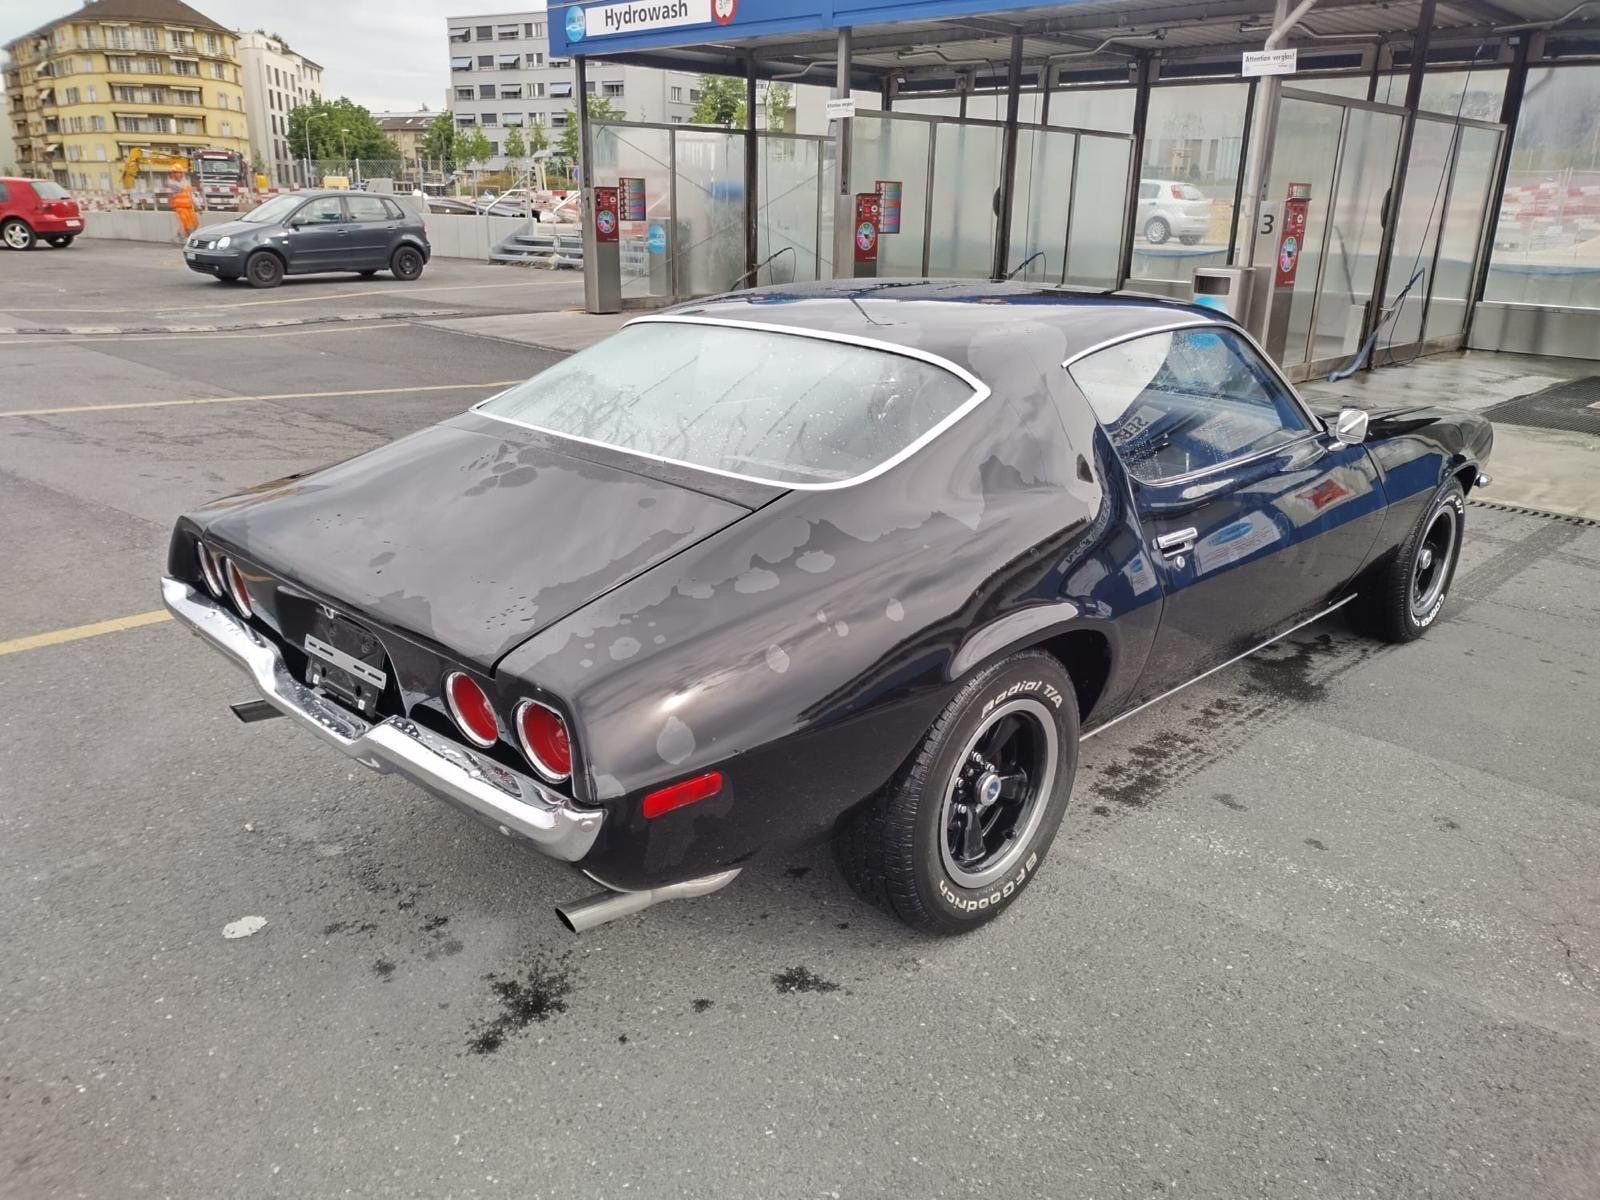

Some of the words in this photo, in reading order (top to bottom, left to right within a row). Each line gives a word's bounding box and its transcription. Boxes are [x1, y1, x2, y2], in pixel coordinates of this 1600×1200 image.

[604, 1, 688, 31] Hydrowash
[1260, 214, 1275, 235] 3
[980, 680, 1043, 719] Radial
[1043, 683, 1063, 709] T/A
